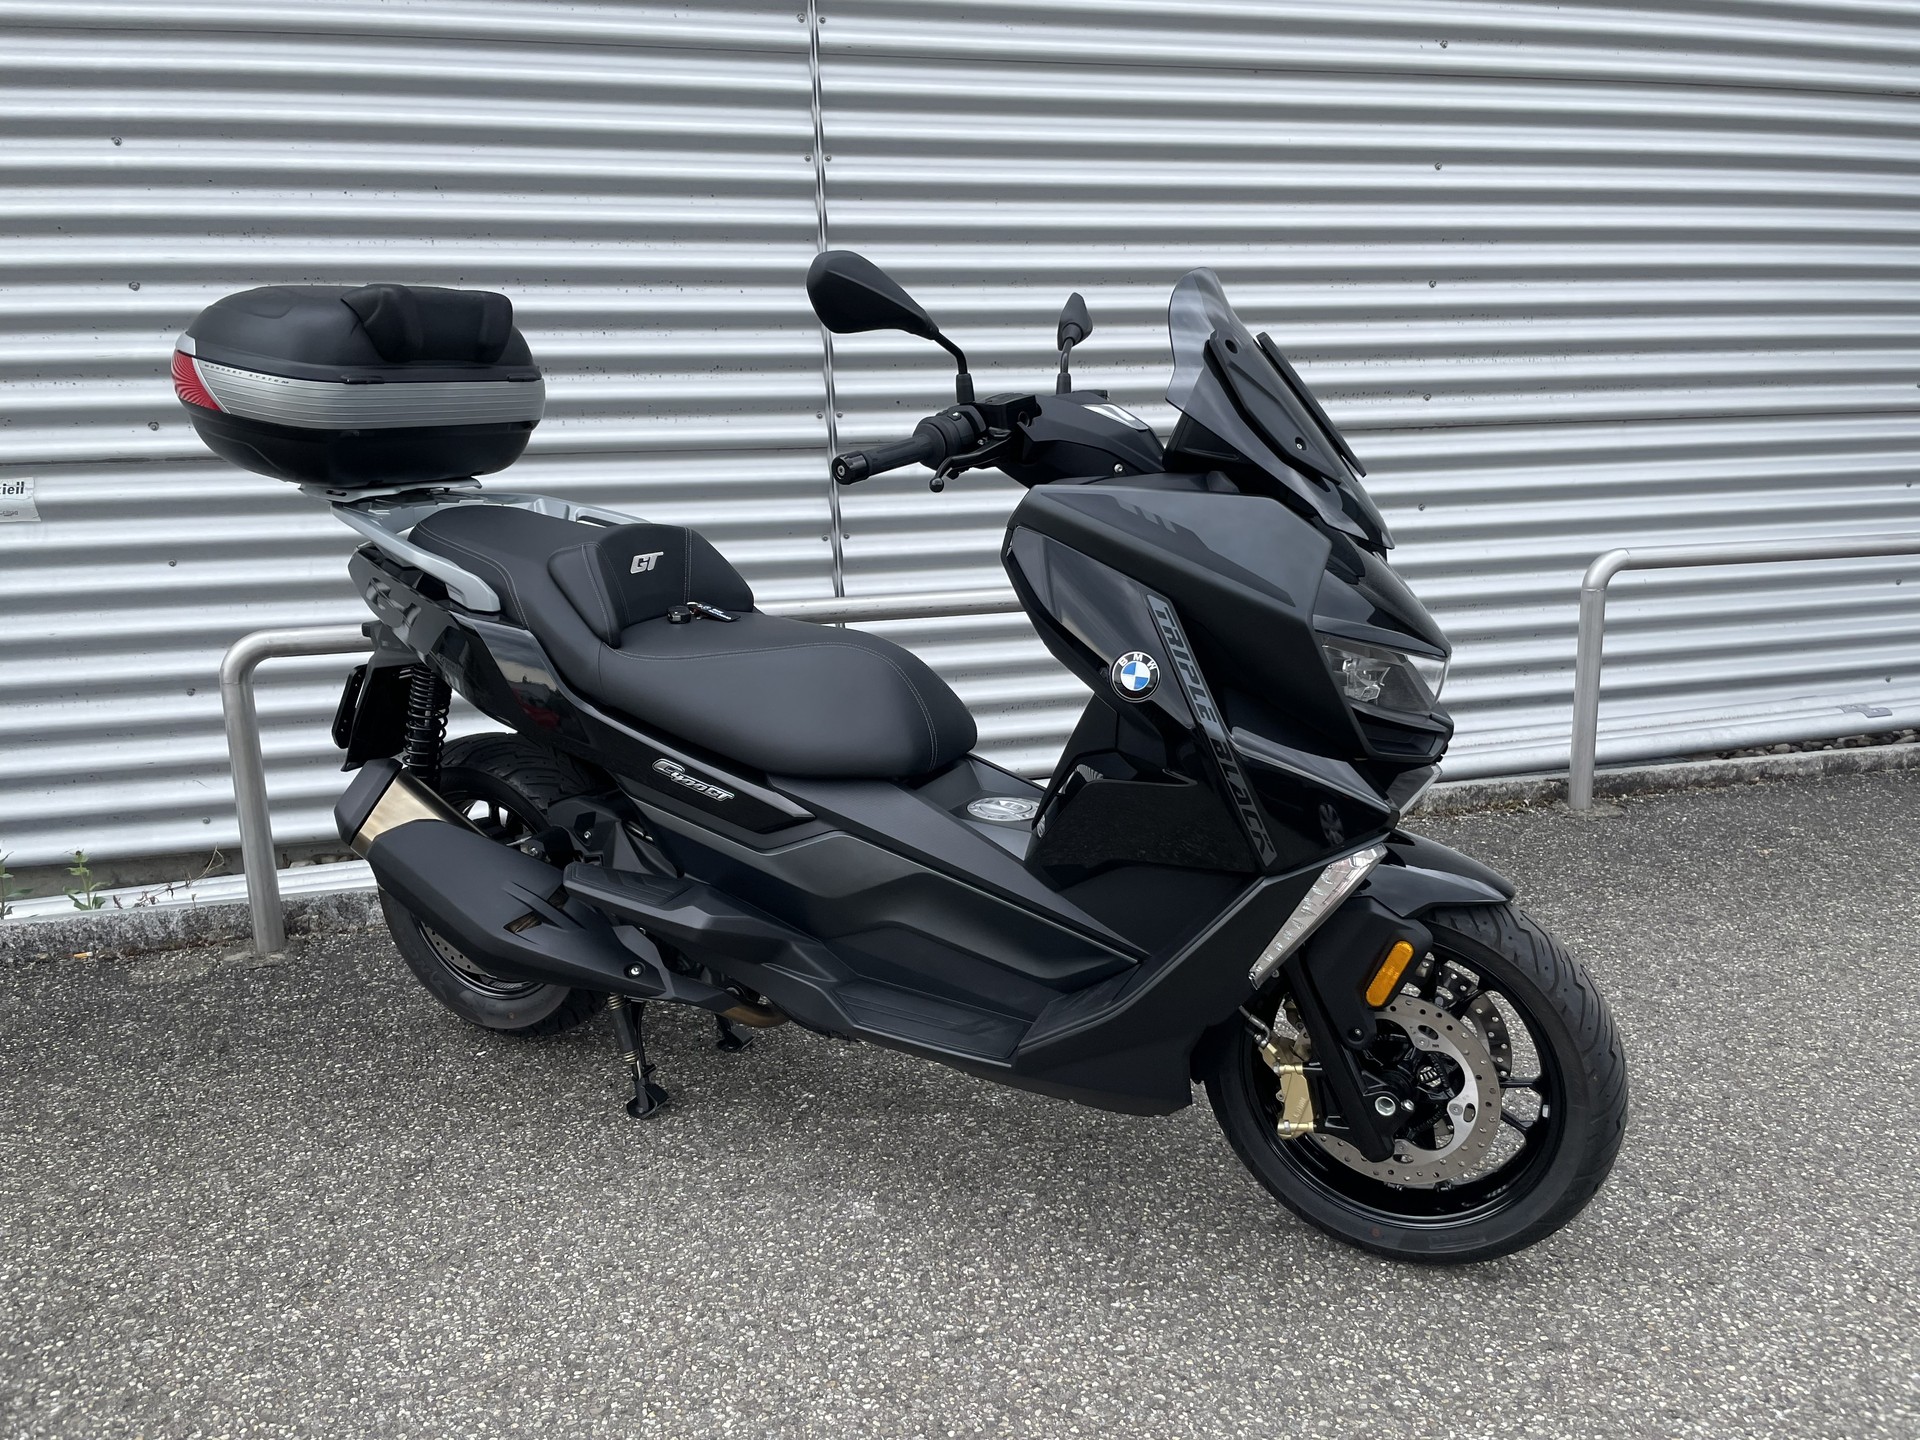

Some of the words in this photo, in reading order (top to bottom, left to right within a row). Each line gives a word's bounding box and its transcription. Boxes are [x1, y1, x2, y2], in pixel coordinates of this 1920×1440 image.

[630, 551, 664, 574] GT
[1118, 653, 1158, 671] BMW
[1154, 606, 1217, 724] TRIPLE
[1209, 737, 1275, 855] BLACK
